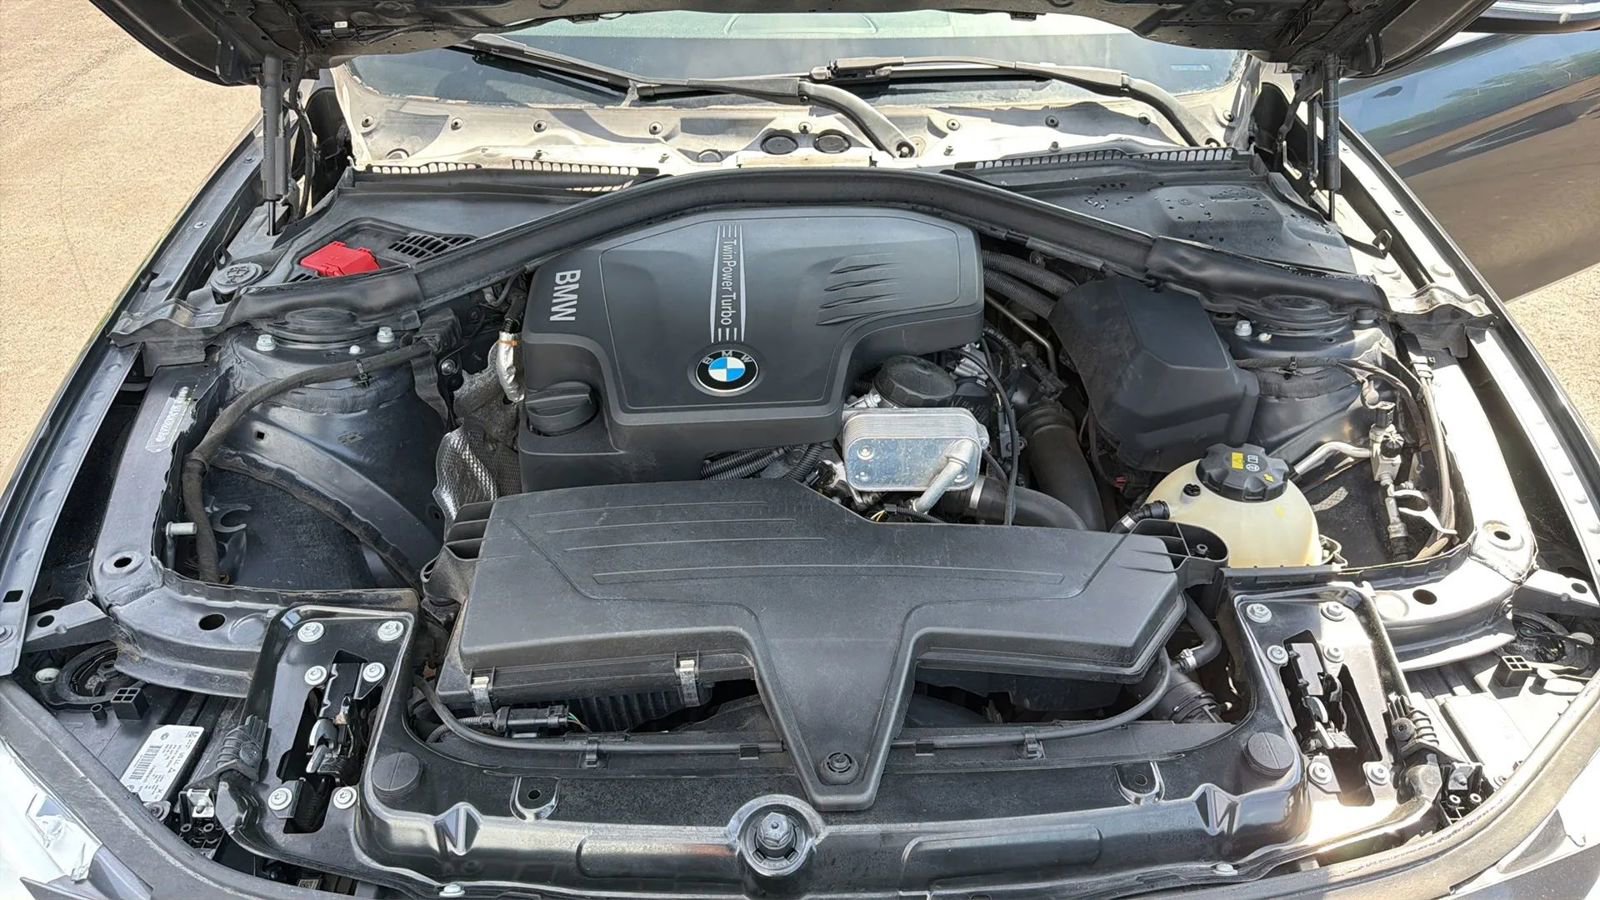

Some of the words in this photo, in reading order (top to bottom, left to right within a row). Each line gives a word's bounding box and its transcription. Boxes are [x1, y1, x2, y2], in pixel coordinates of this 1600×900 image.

[721, 239, 737, 292] TwinPower
[550, 270, 581, 321] BMW
[720, 292, 737, 326] Turbo
[702, 350, 753, 365] BMW
